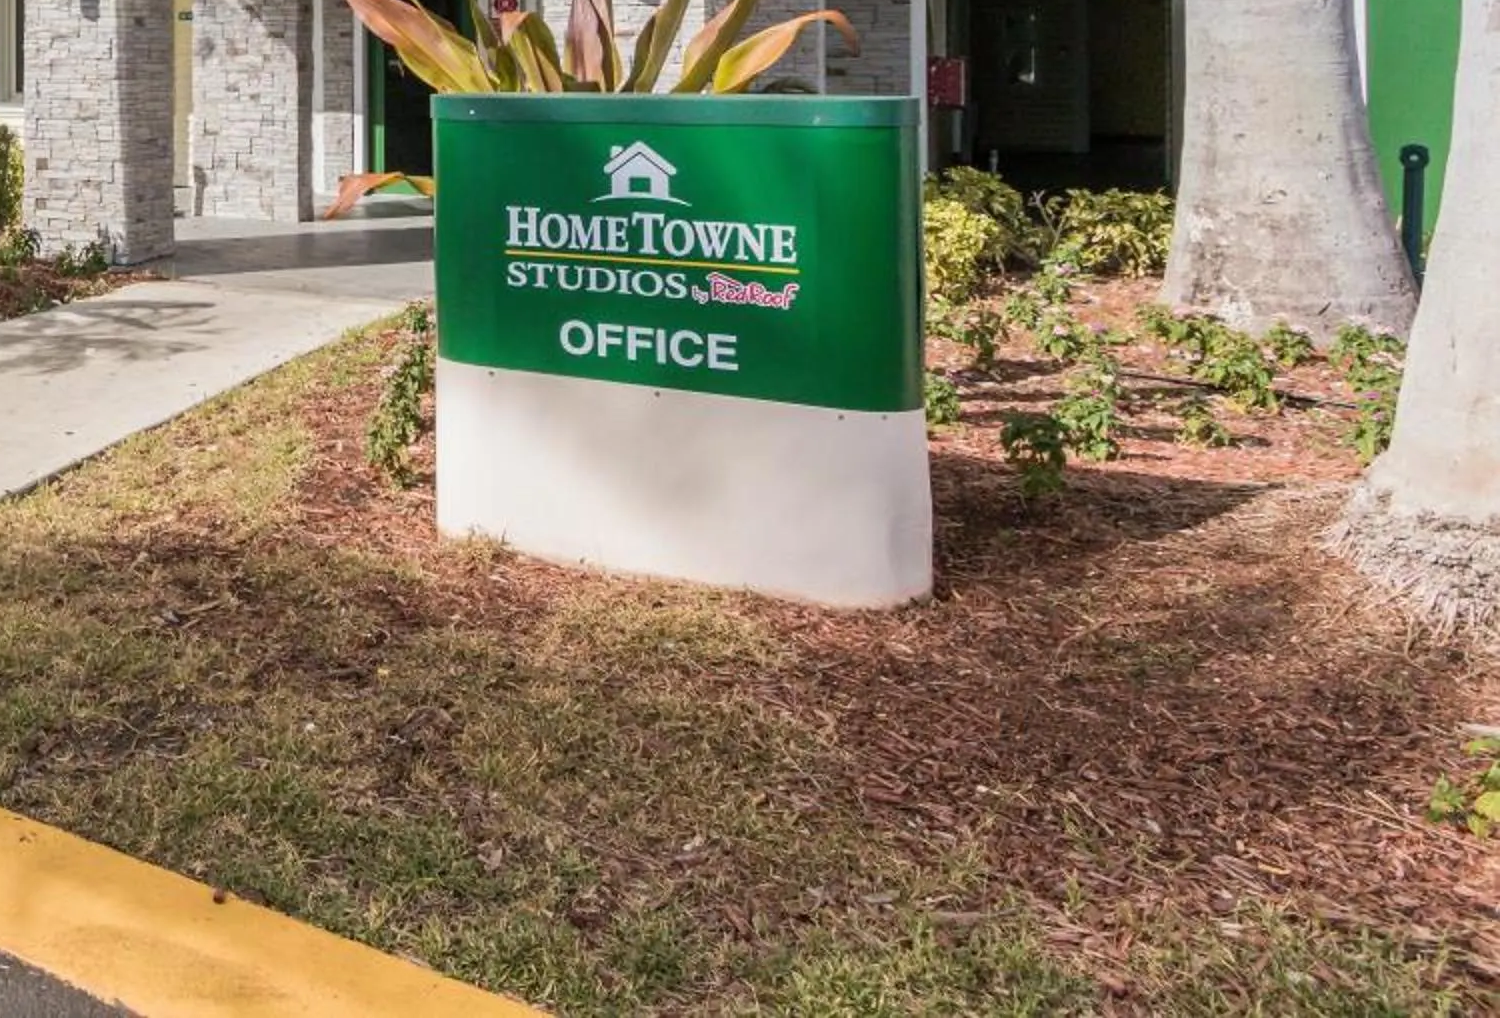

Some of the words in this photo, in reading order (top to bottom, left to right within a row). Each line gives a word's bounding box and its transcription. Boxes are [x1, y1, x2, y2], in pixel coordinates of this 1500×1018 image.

[507, 261, 687, 299] STUDIOS
[691, 284, 708, 304] by
[559, 319, 739, 371] OFFICE
